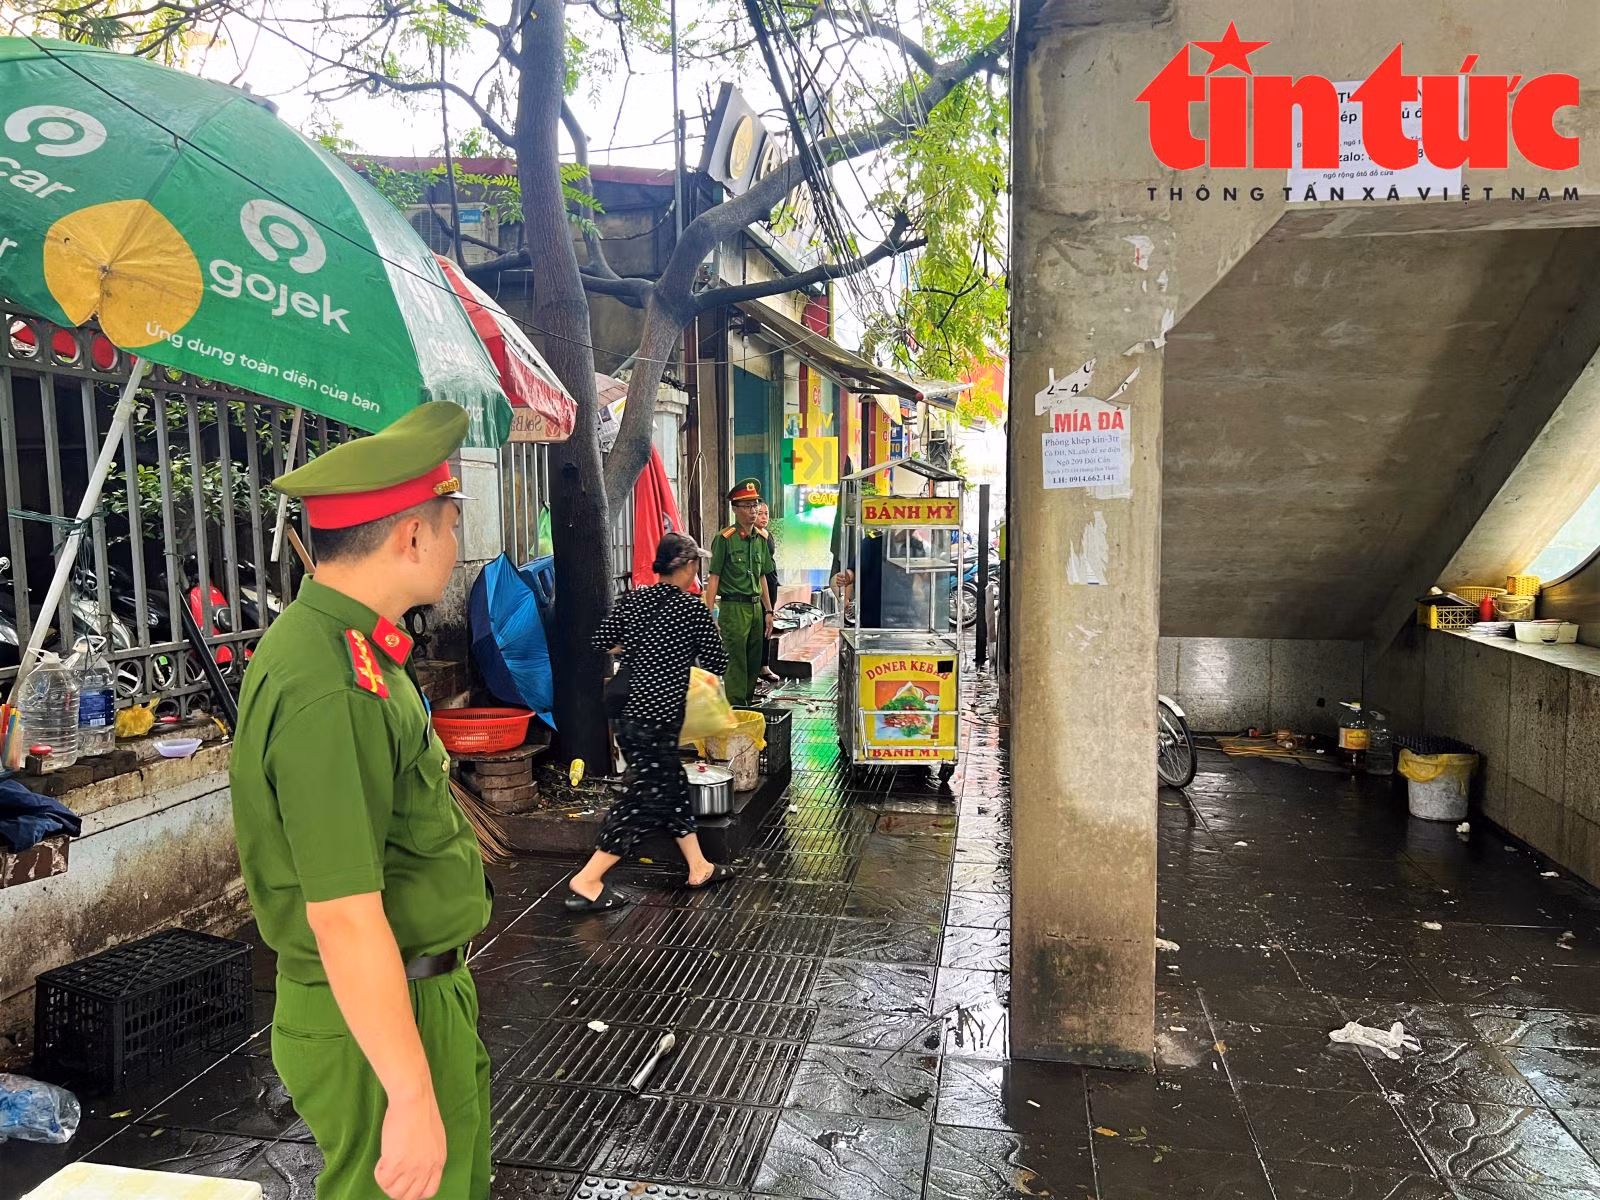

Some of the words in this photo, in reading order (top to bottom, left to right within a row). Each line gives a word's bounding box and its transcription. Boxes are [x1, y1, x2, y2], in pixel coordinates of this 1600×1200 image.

[209, 259, 351, 335] gojek
[145, 320, 184, 348] Ứng
[187, 338, 236, 365] dụng
[239, 353, 279, 377] toàn
[282, 368, 317, 391] diện
[320, 383, 349, 402] của
[352, 392, 381, 414] bạn
[1054, 408, 1092, 433] MÍA
[1097, 407, 1124, 431] ĐÁ
[864, 502, 920, 520] BÁNH
[865, 660, 907, 680] DONER
